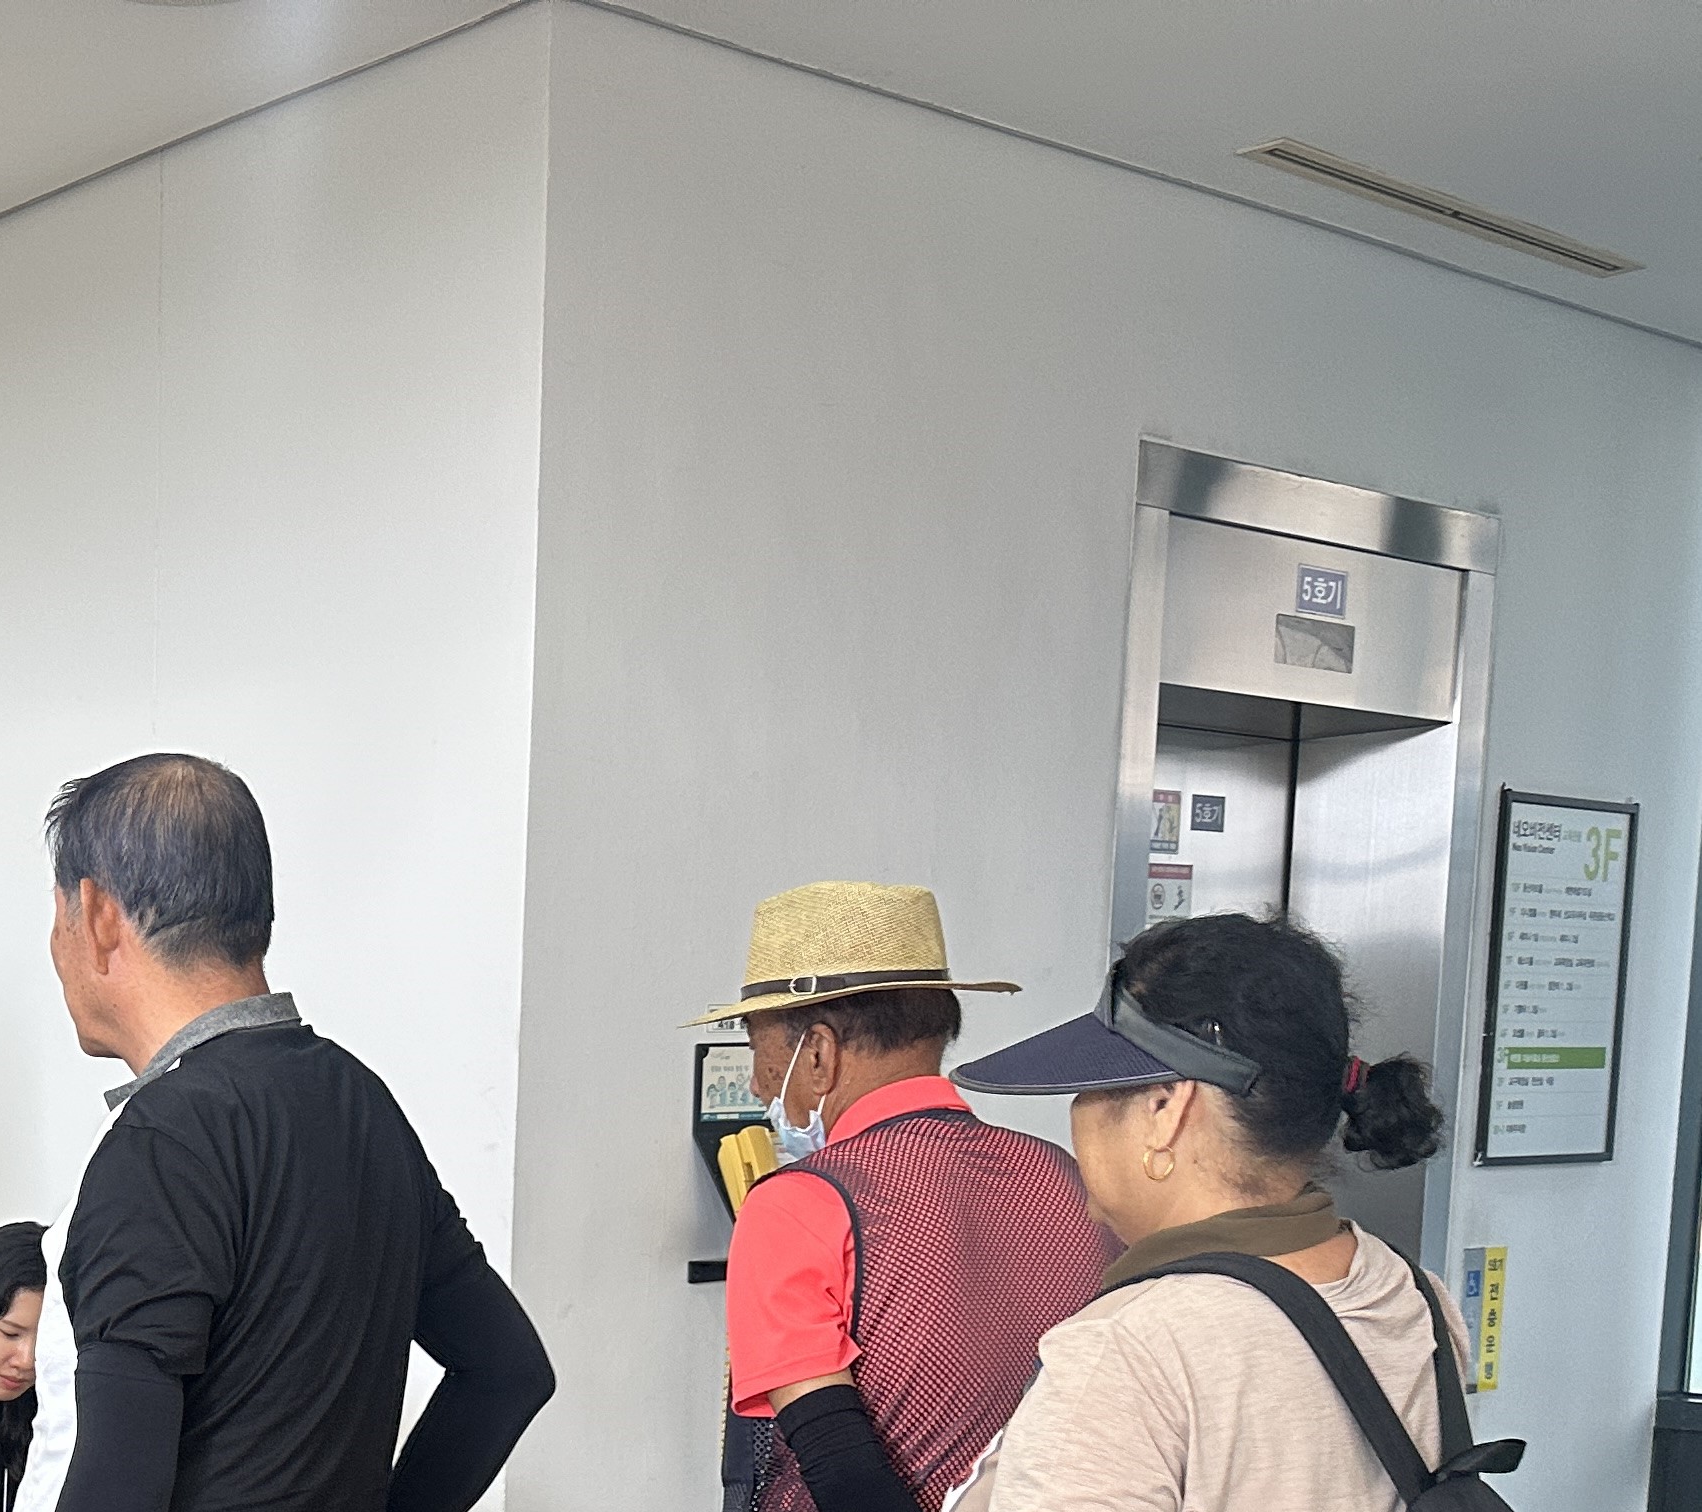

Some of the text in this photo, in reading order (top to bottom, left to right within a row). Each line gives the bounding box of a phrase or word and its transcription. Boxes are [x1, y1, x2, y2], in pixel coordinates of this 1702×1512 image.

[1301, 576, 1343, 610] 5호기
[1195, 802, 1223, 825] 5호기
[1583, 826, 1623, 882] 3F
